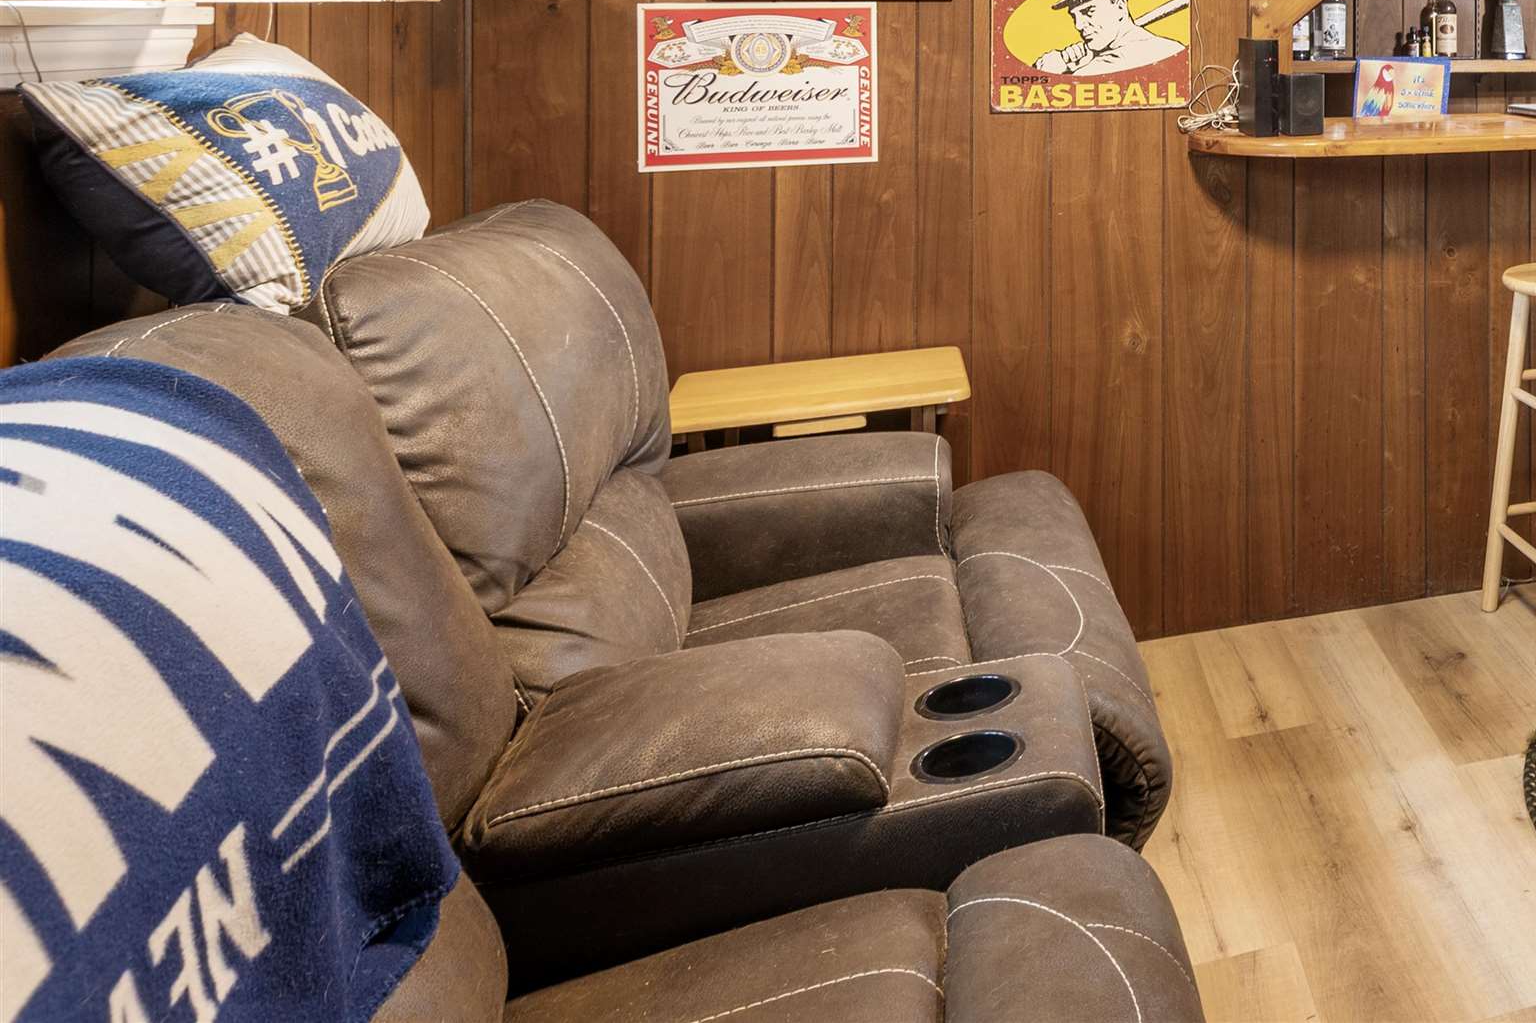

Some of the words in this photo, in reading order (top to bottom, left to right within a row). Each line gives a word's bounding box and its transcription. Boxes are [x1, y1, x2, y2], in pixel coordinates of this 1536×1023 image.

[664, 72, 849, 105] Budweiser
[1001, 76, 1049, 84] TOPPS
[768, 104, 800, 112] BEERS
[859, 65, 871, 148] GENUINE
[999, 82, 1185, 108] BASEBALL
[646, 70, 658, 156] GENUINE
